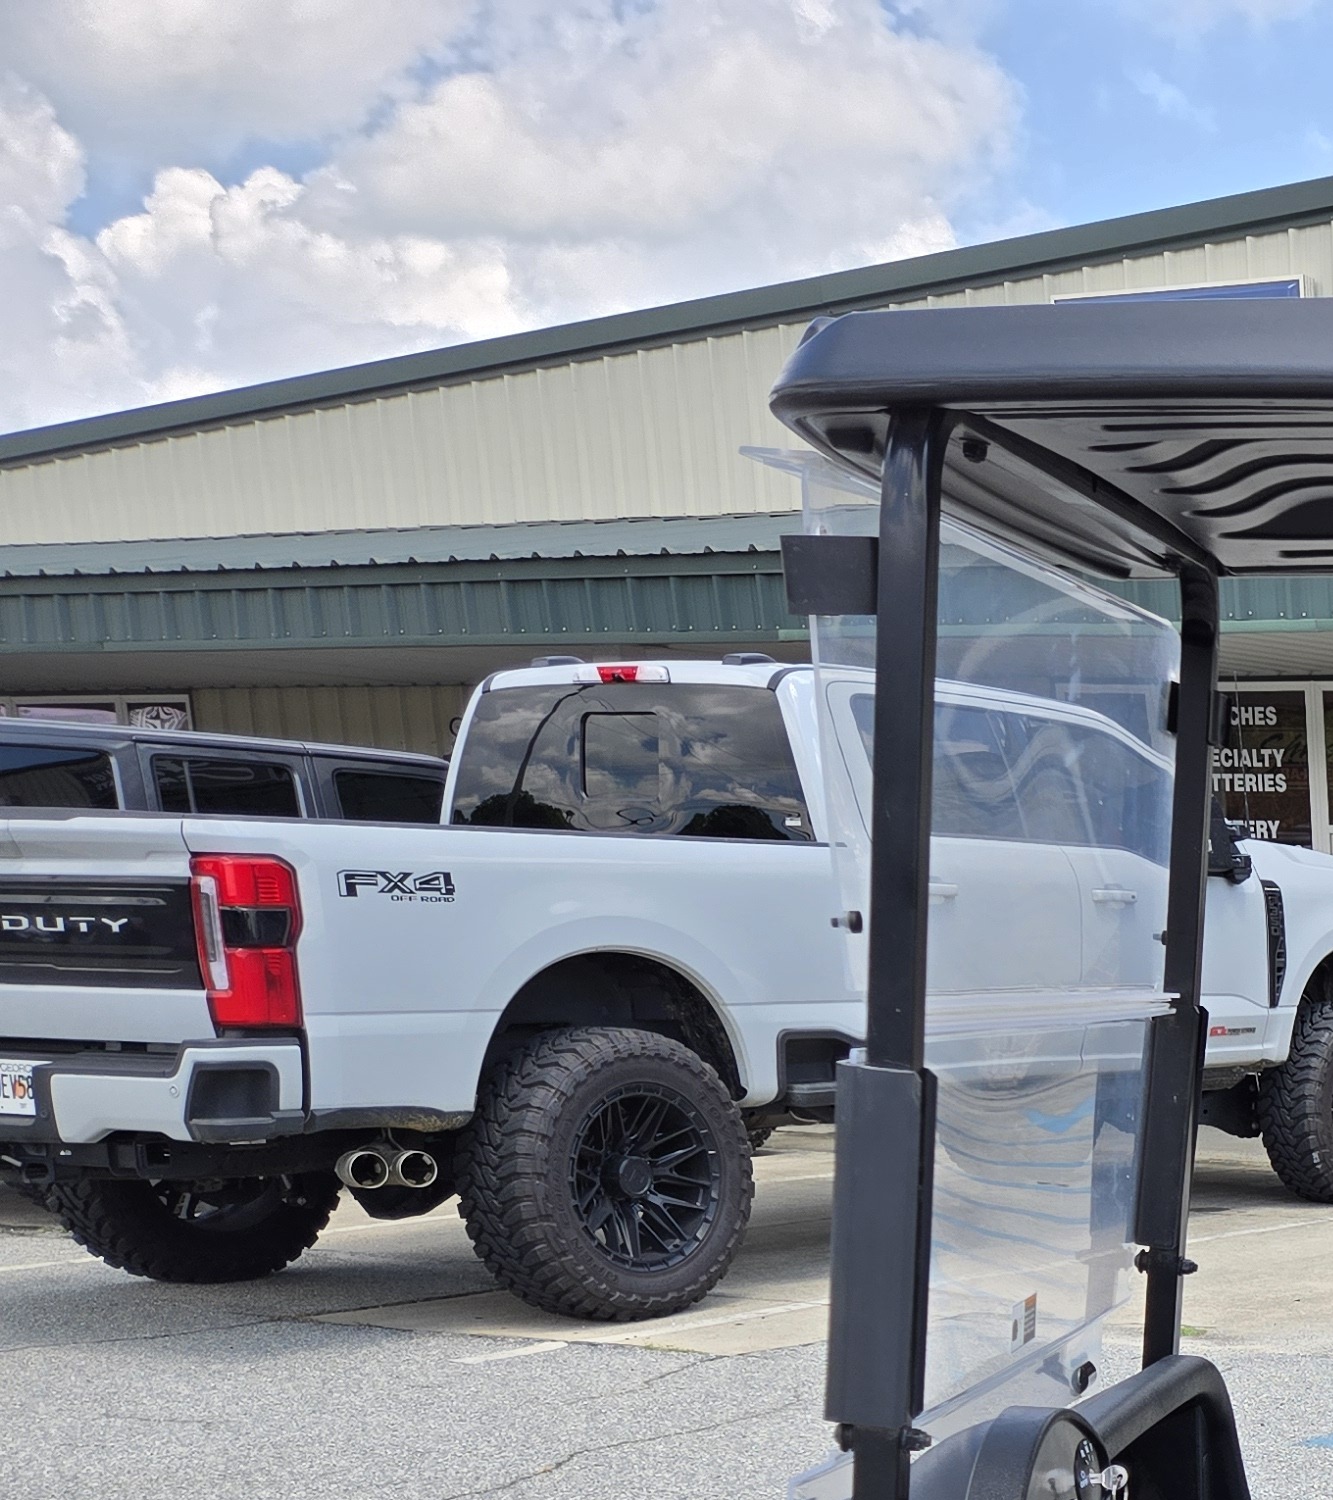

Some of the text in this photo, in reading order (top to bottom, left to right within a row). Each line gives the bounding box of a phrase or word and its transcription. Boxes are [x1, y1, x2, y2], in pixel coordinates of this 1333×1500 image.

[336, 868, 456, 898] FX4
[420, 895, 455, 903] ROAD
[1, 914, 129, 933] DUTY
